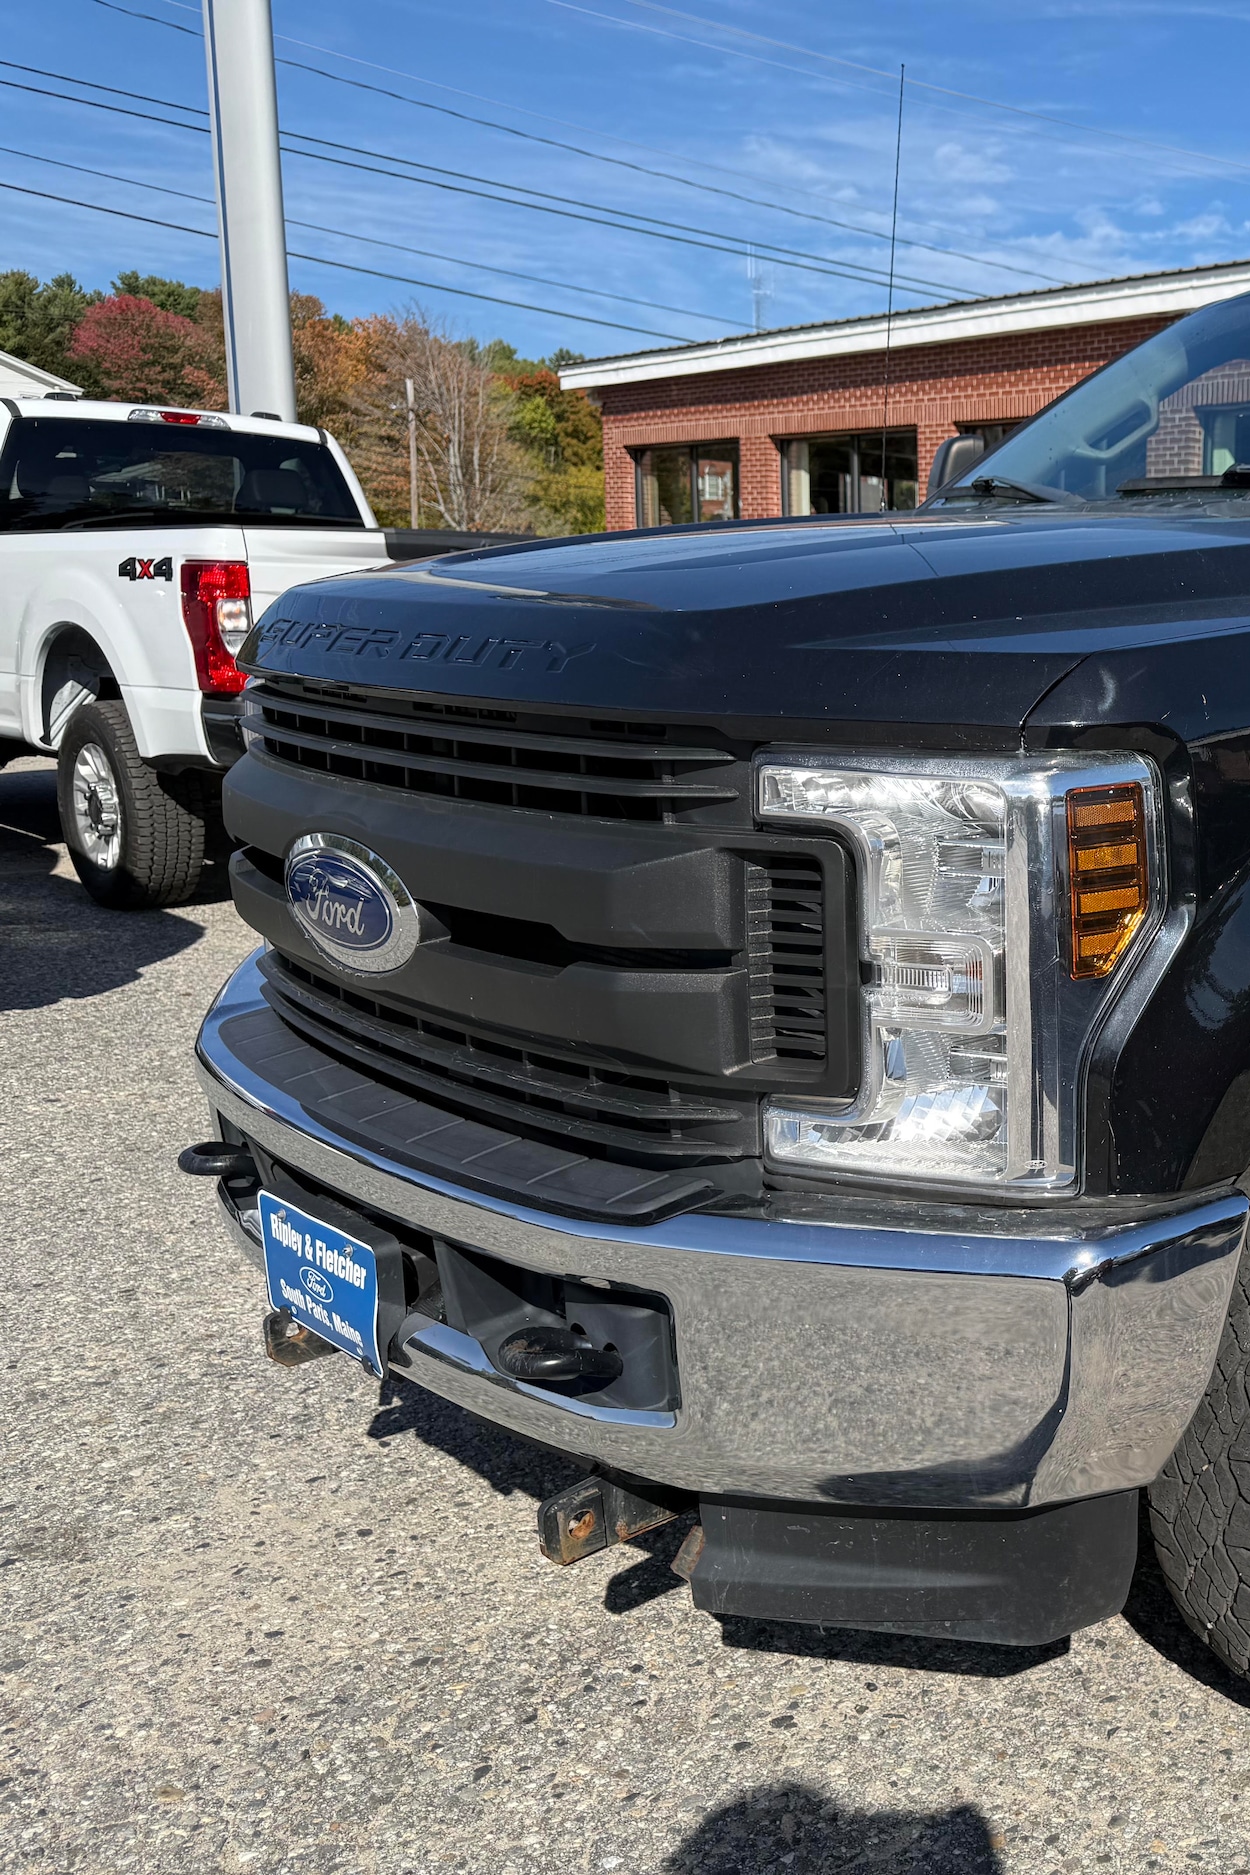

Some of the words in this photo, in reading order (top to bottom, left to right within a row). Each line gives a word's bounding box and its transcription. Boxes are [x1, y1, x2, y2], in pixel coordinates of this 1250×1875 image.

[261, 618, 400, 660] SUPER
[399, 633, 598, 674] DUTY
[304, 868, 371, 936] Ford
[270, 1212, 303, 1258] Ripley
[304, 1233, 314, 1262] &
[315, 1239, 367, 1290] Fletcher
[306, 1270, 327, 1298] Ford
[279, 1278, 307, 1314] South
[306, 1301, 334, 1332] Paris,
[332, 1311, 364, 1349] Maine
